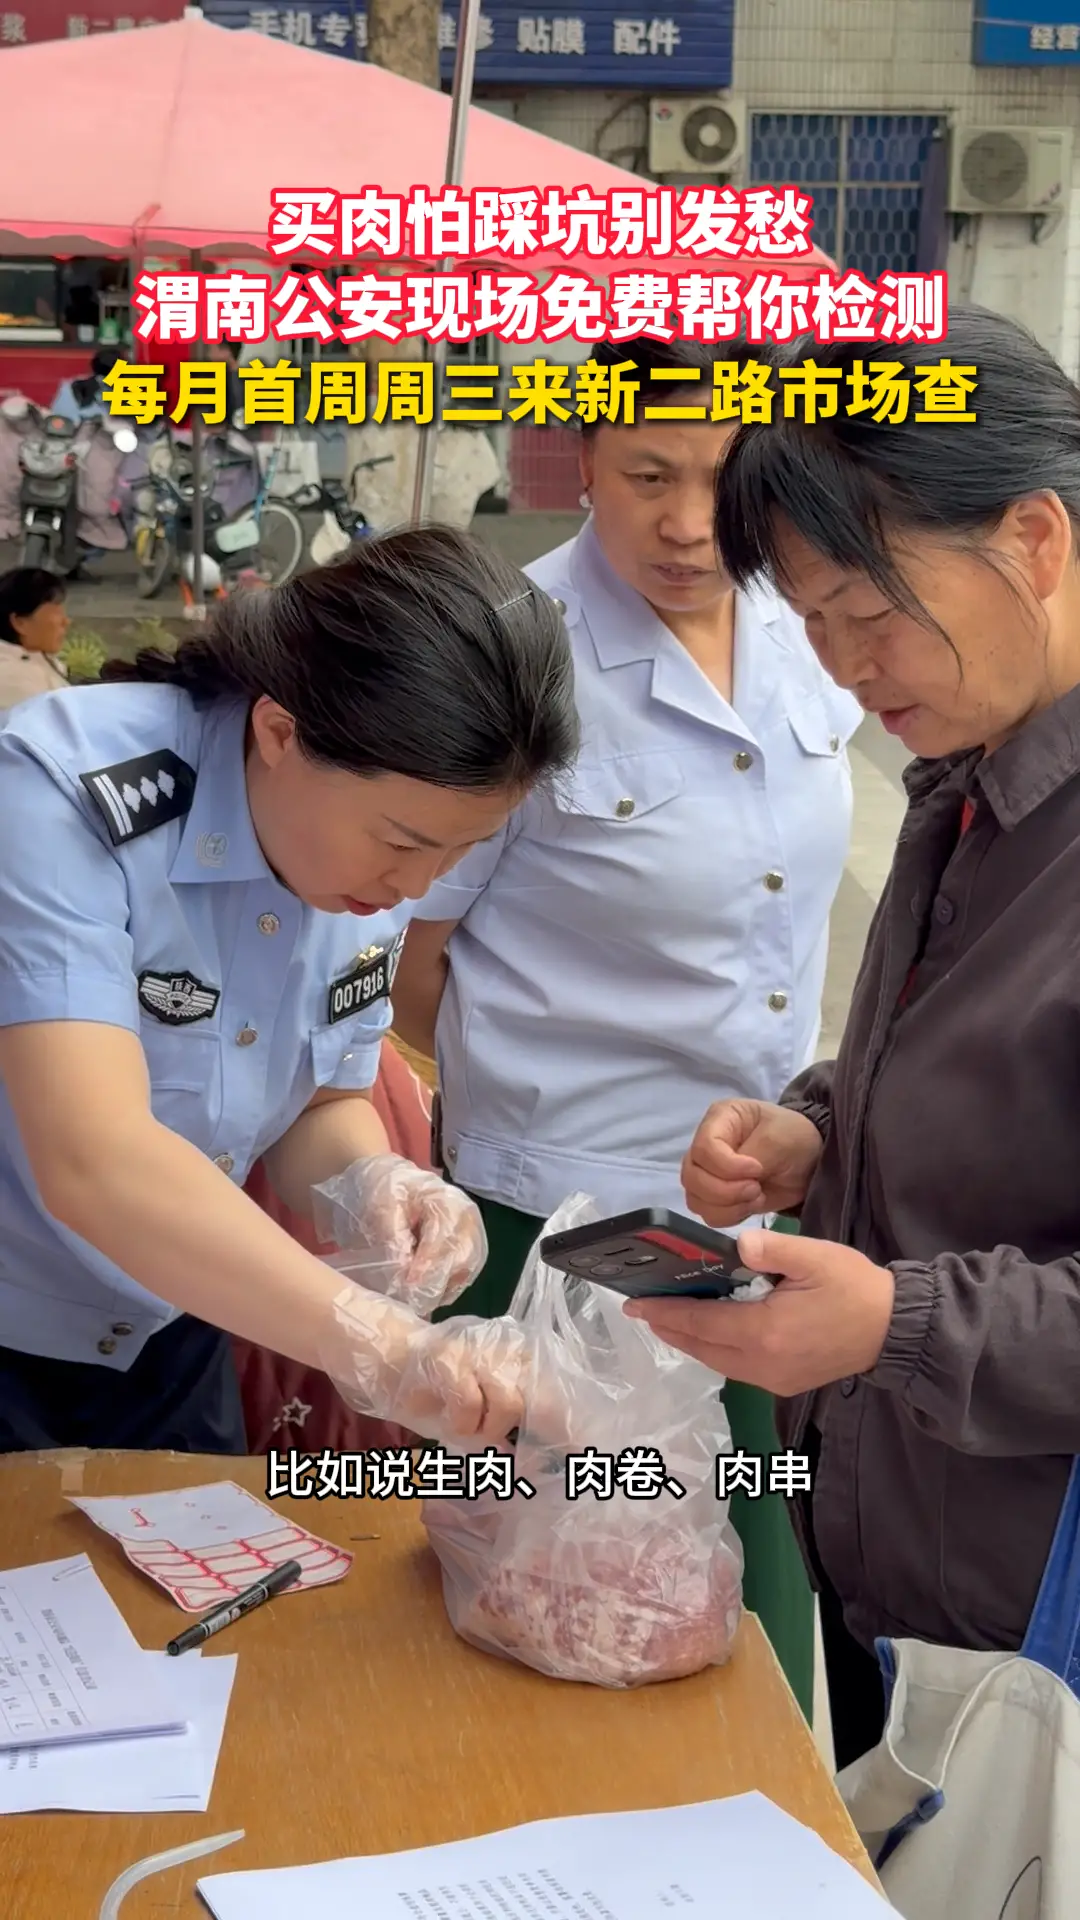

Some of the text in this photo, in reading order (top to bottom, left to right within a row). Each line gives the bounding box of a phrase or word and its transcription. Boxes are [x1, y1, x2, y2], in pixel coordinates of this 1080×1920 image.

[516, 16, 586, 55] 贴膜
[613, 18, 682, 56] 配件
[334, 966, 385, 1013] 007916
